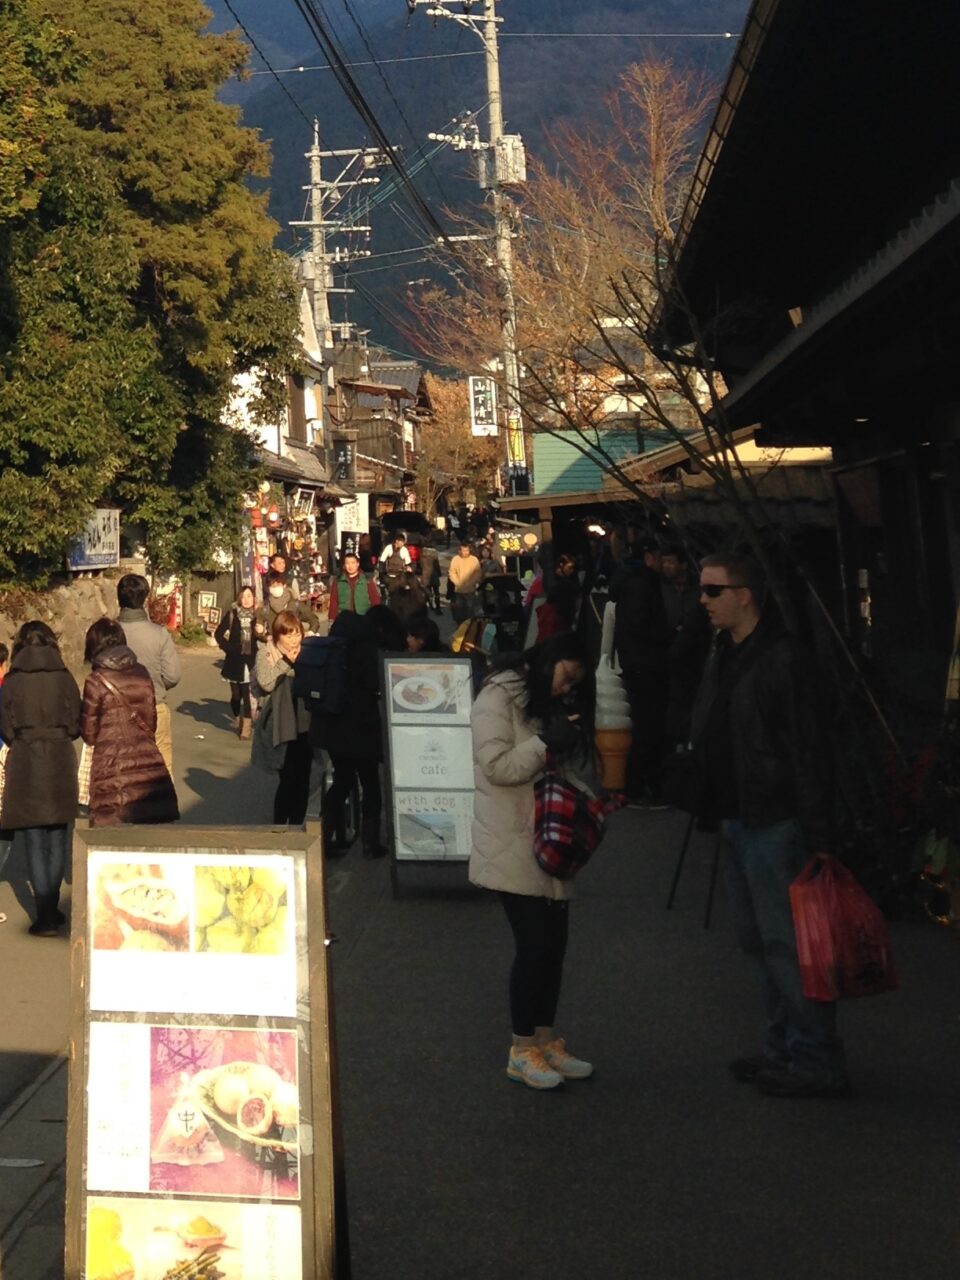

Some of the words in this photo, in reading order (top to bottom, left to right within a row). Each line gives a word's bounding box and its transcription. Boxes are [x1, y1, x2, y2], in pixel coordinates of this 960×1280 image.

[474, 381, 487, 418] 山下清
[421, 763, 448, 776] cafe
[398, 795, 427, 806] with
[434, 796, 456, 809] dog
